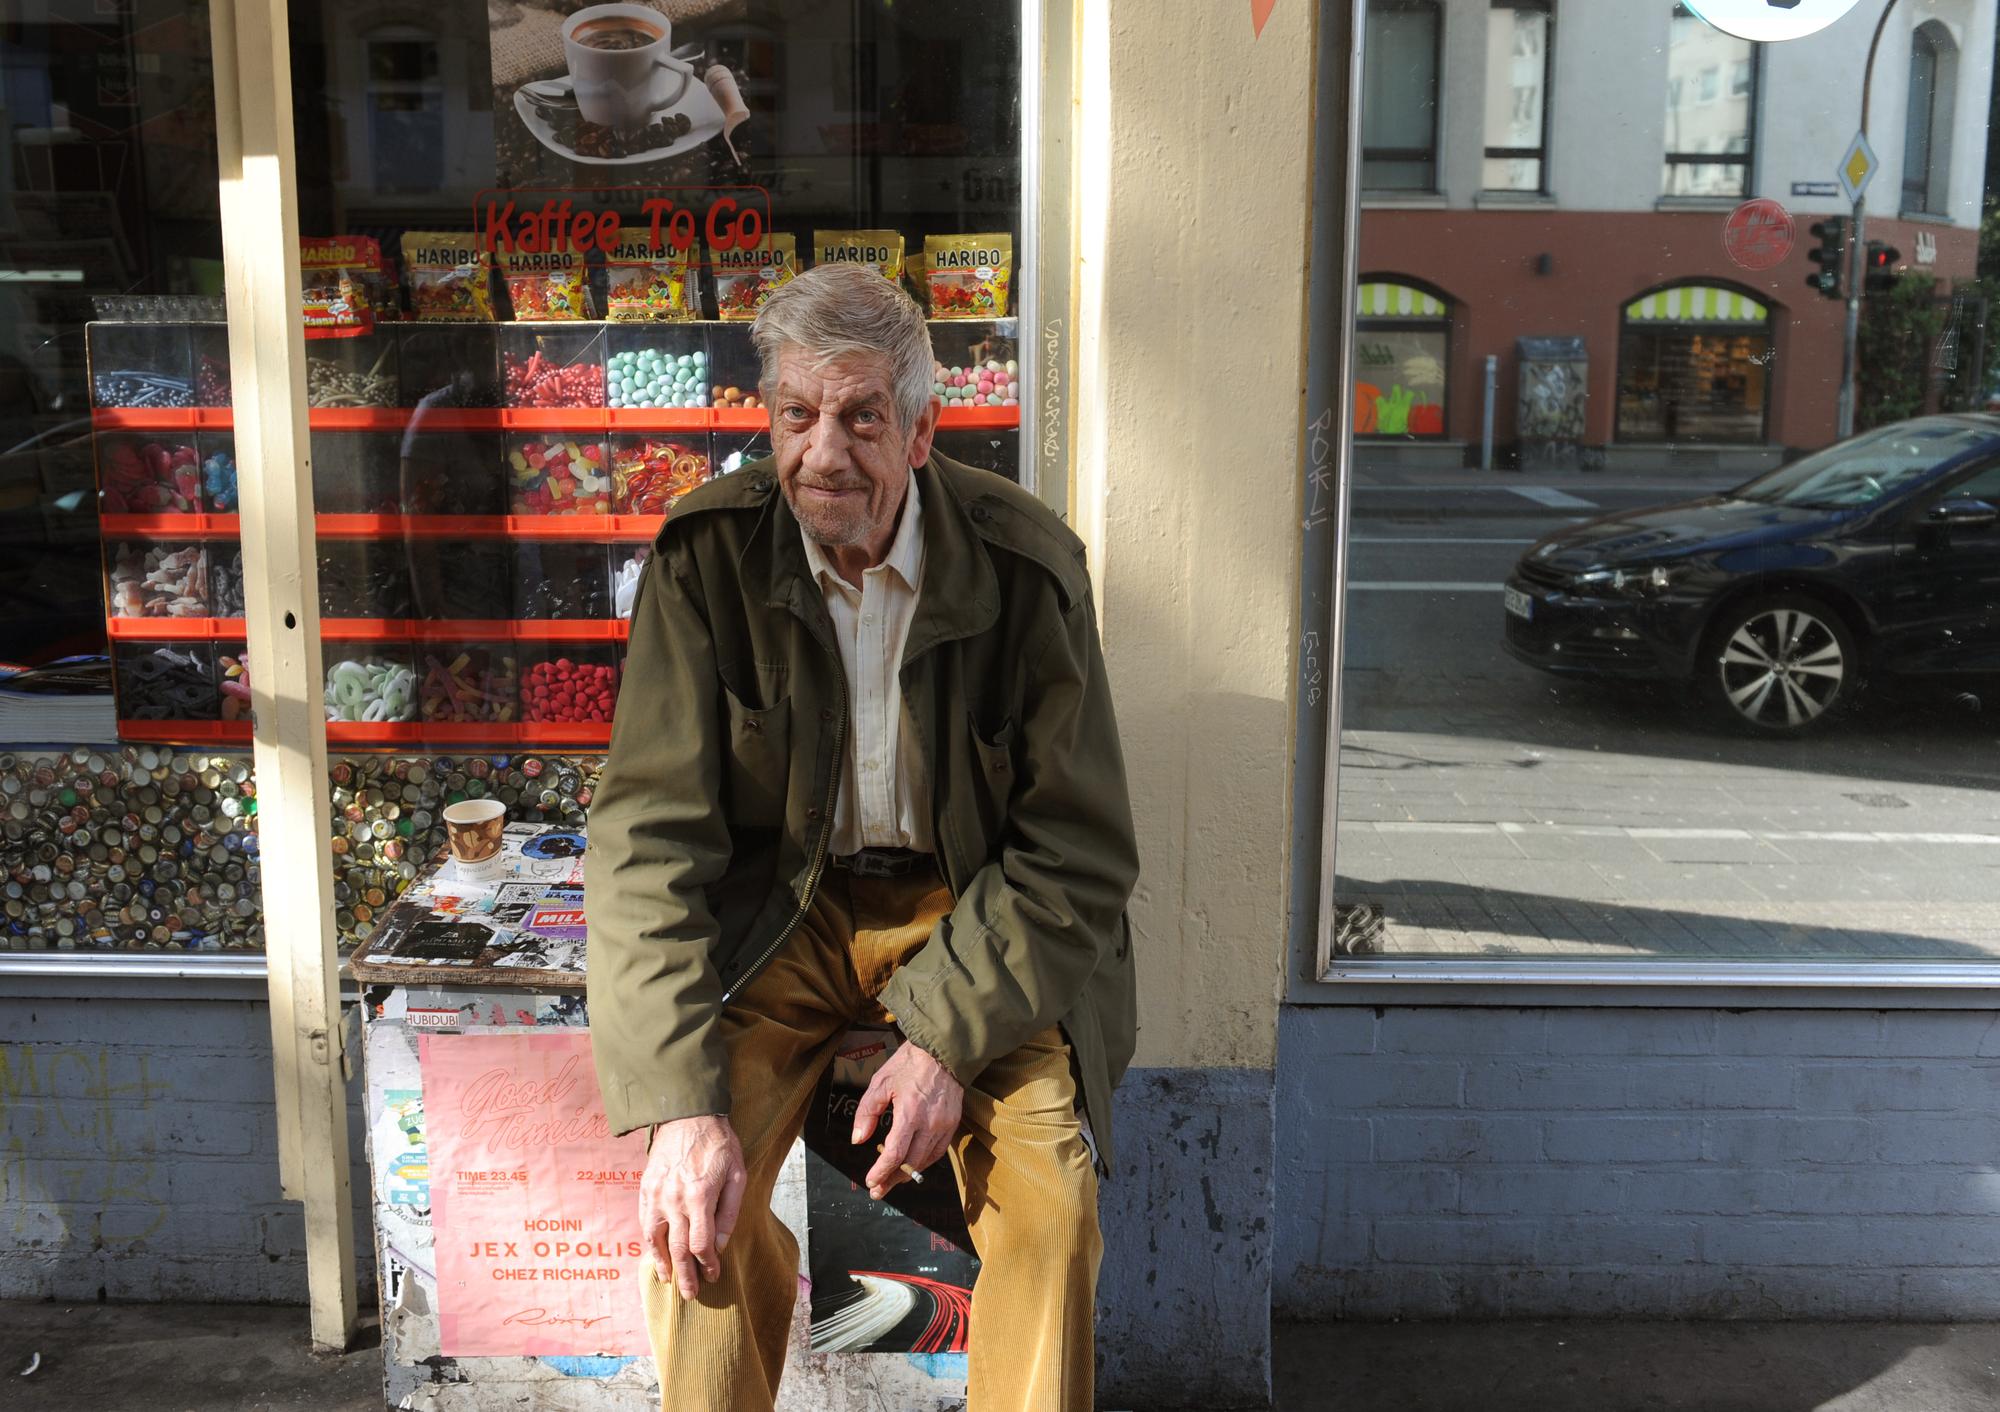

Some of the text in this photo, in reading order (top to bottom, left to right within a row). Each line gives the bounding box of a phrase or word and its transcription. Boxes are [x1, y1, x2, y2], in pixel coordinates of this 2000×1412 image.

[485, 197, 762, 254] Kaffee To Go
[508, 253, 573, 271] HARIBO
[719, 249, 784, 268] HARIBO
[823, 246, 889, 263] HARIBO
[936, 249, 1000, 267] HARIBO
[460, 1054, 580, 1118] Good
[456, 1171, 529, 1182] TIME 23.45
[576, 1170, 594, 1181] 22
[596, 1170, 627, 1181] JULY
[524, 1219, 583, 1232] HODINI
[469, 1241, 643, 1258] JEX OPOLIS
[492, 1268, 621, 1281] CHEZ RICHARD
